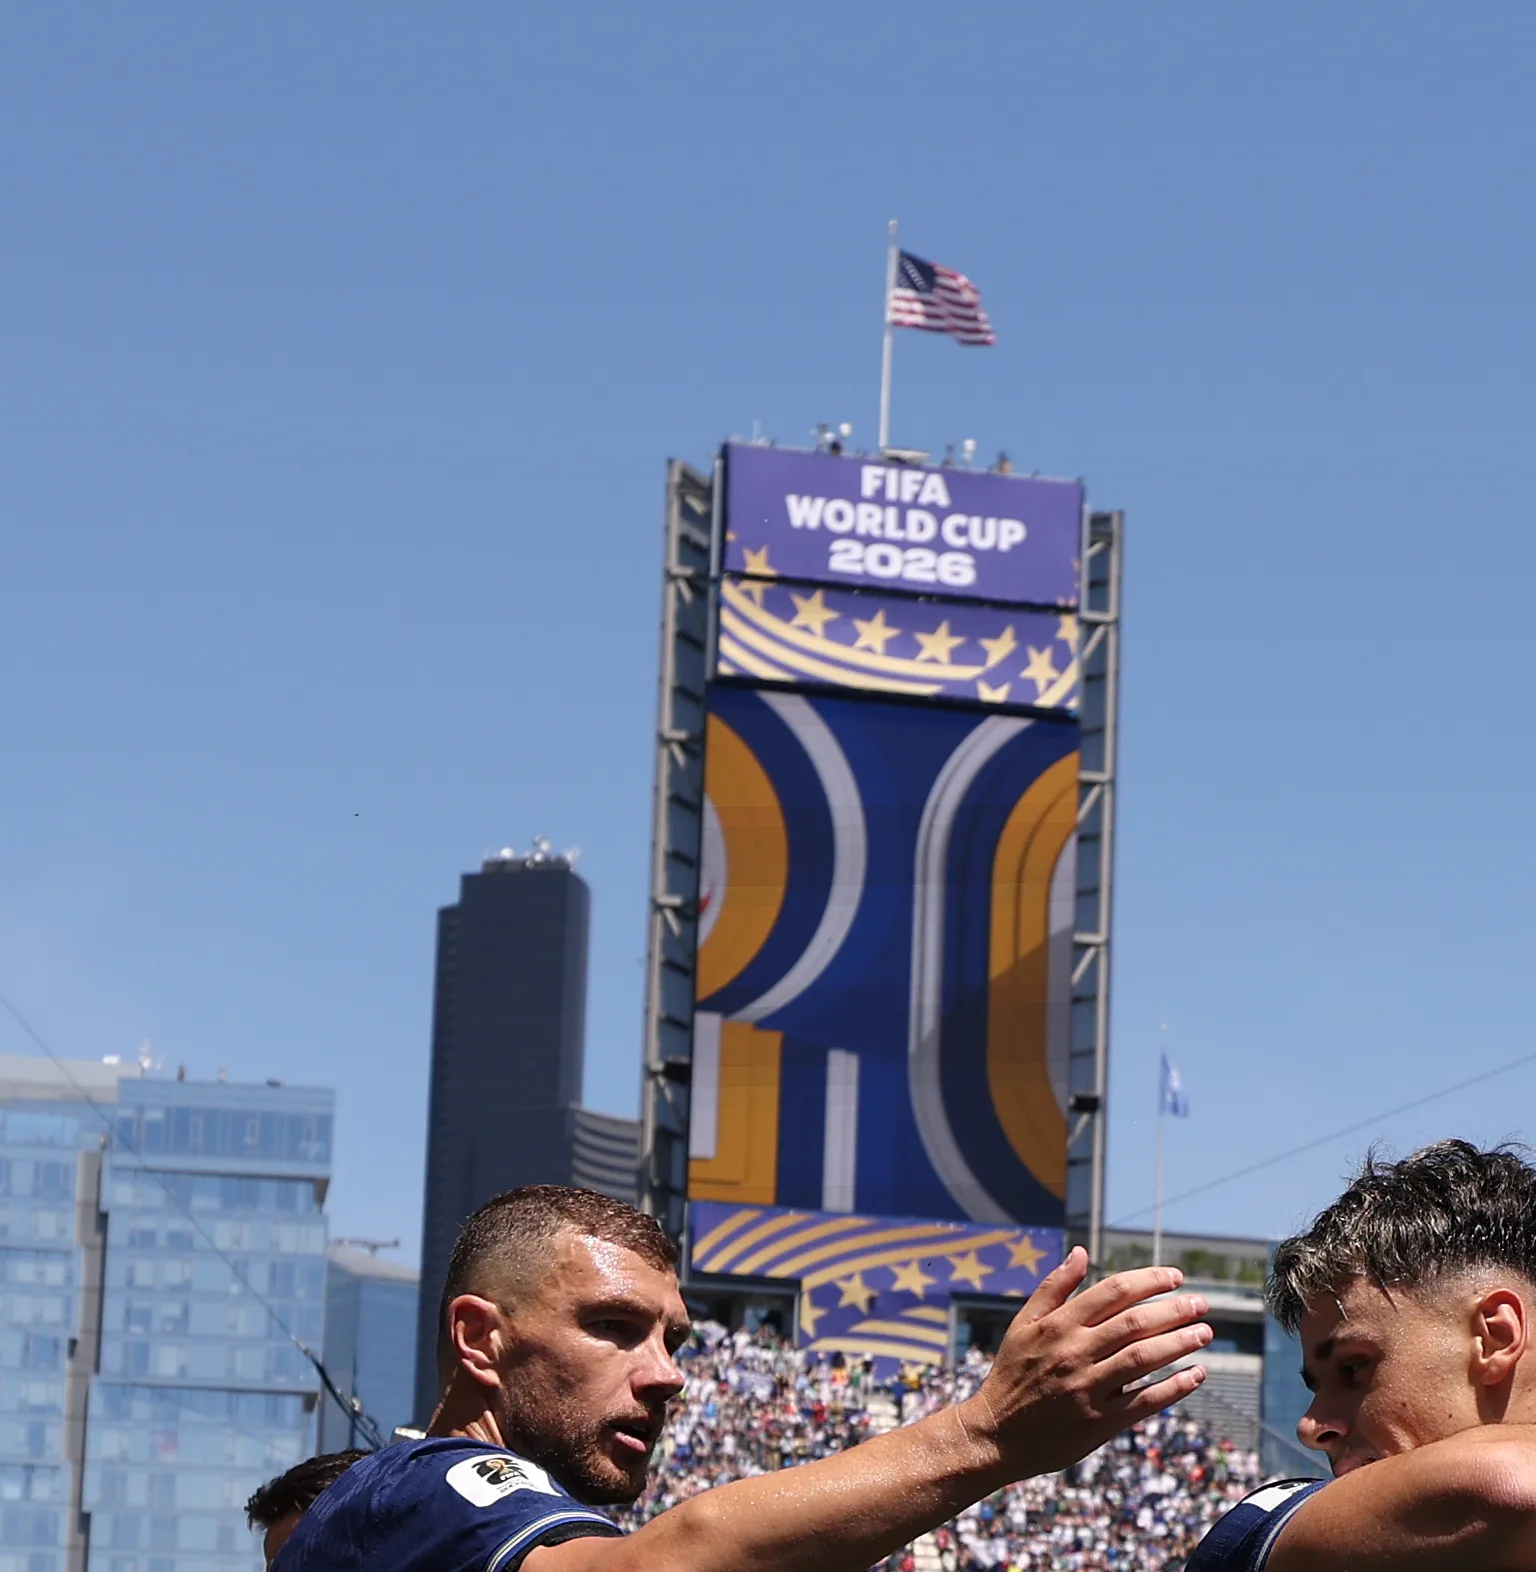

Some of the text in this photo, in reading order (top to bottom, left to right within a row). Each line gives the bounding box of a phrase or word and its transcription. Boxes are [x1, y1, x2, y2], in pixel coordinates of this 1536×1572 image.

[861, 464, 951, 507] FIFA
[785, 493, 1027, 552] WORLD CUP
[828, 539, 977, 587] 2026
